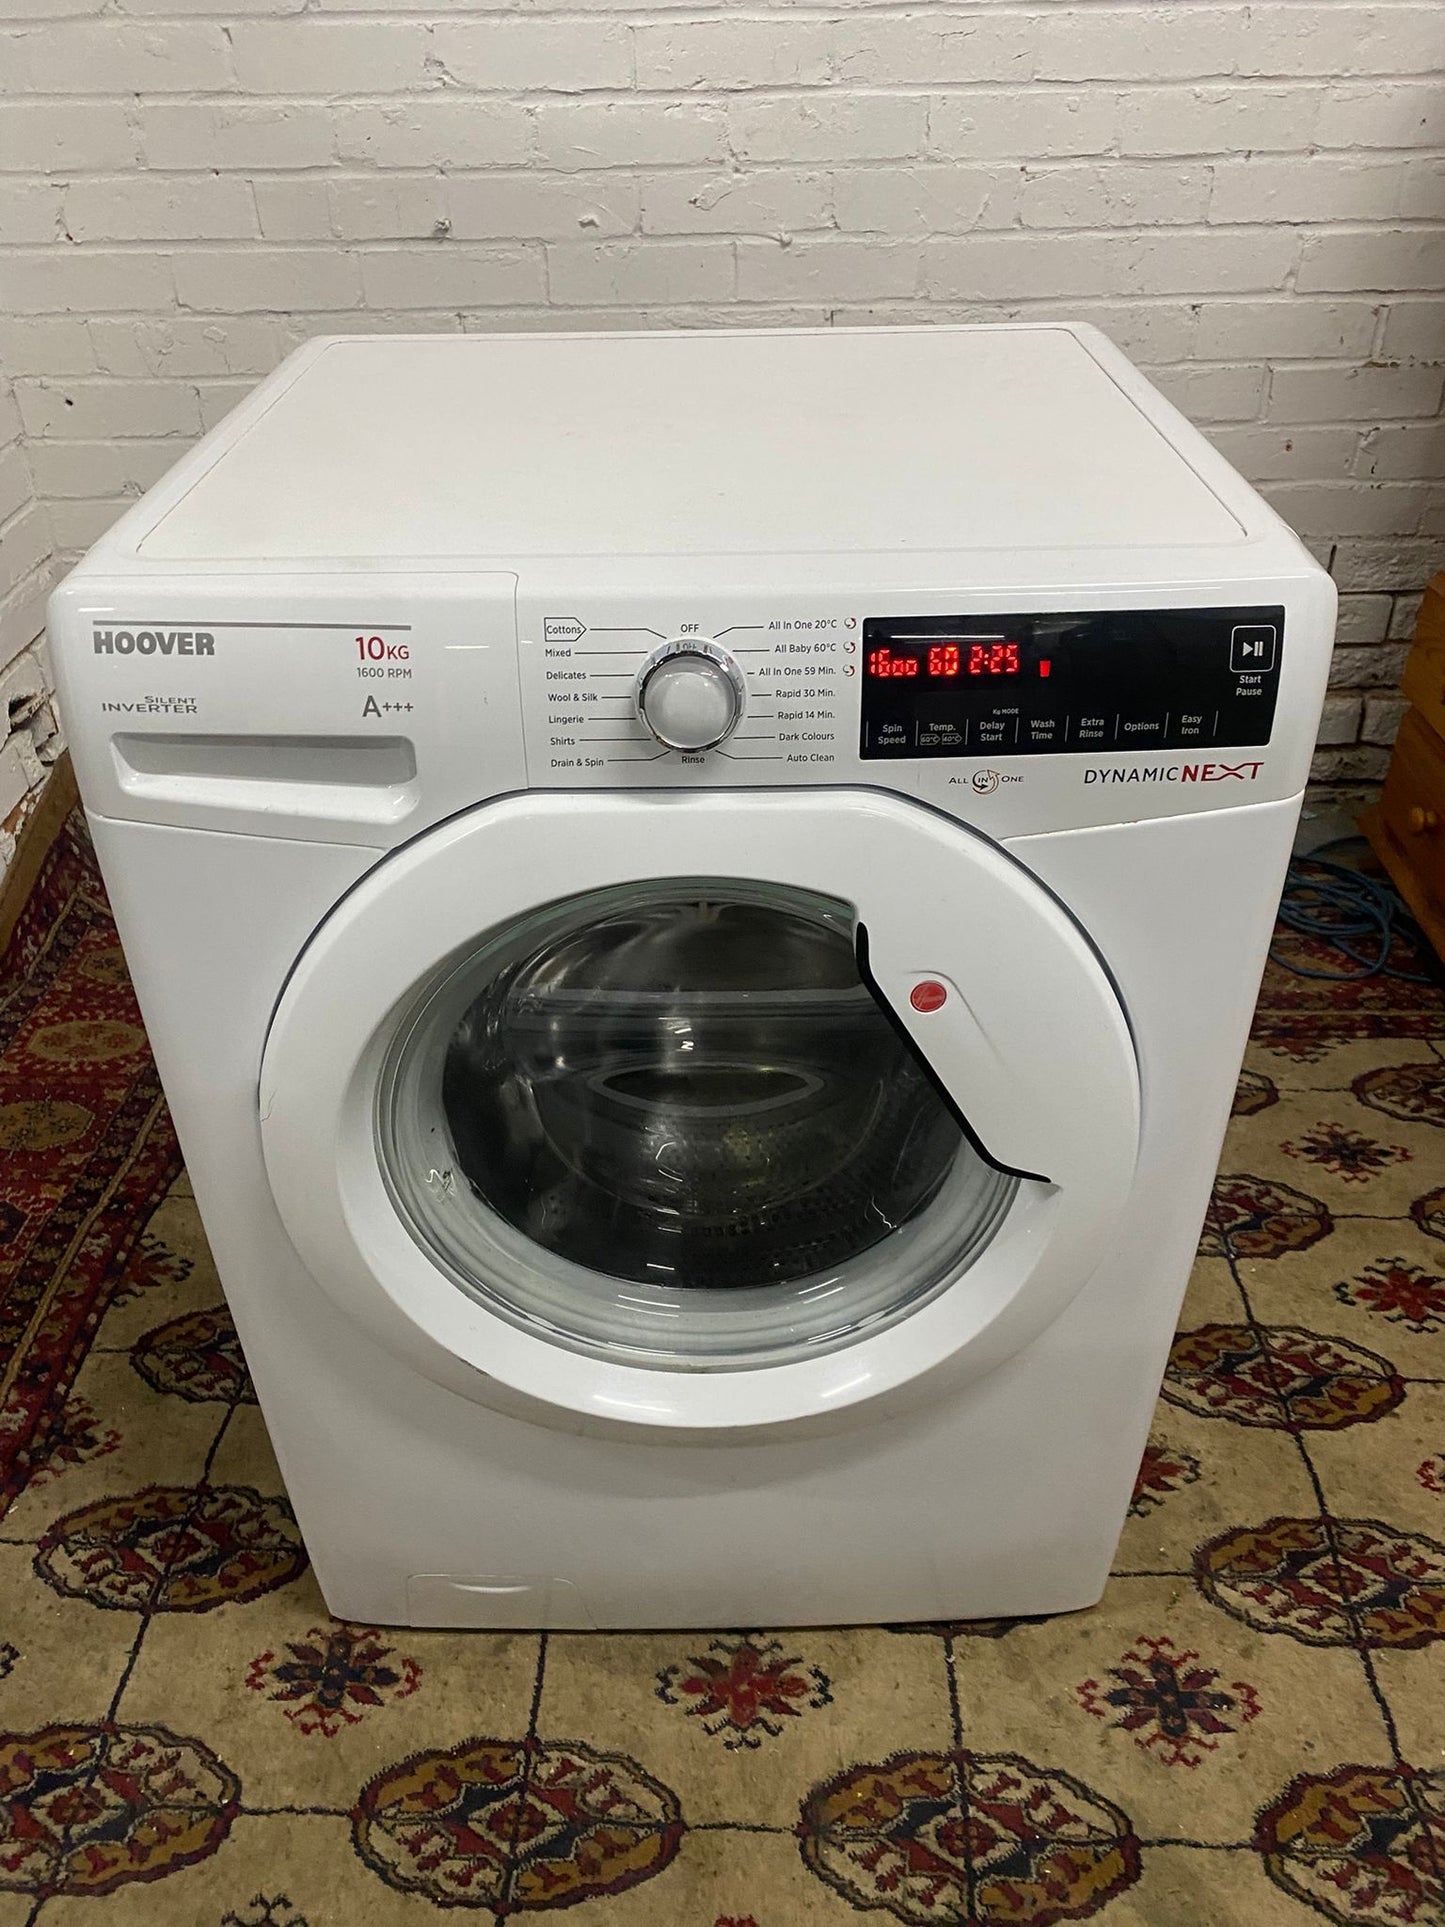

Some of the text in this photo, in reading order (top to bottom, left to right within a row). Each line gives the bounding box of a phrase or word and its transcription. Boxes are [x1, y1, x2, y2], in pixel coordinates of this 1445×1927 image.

[680, 624, 699, 633] OFF
[768, 619, 837, 630] All In One 20°C
[546, 625, 582, 635] Cottons
[93, 631, 216, 656] HOOVER
[774, 643, 836, 654] All Baby 60°C
[545, 649, 571, 657] Mixed
[929, 646, 959, 676] 60
[969, 644, 1019, 674] 2:25
[356, 667, 412, 679] 1600 RPM
[546, 671, 587, 680] Delicates
[759, 666, 836, 676] All In One 59 Min.
[1239, 675, 1262, 684] Start
[775, 689, 836, 699] Rapid 30 Min.
[1235, 687, 1263, 696] Pause
[144, 695, 197, 704] SILENT
[548, 693, 571, 702] Wool
[582, 693, 598, 702] Silk
[101, 702, 197, 714] INVERTER
[362, 695, 414, 718] A+++
[1002, 707, 1019, 715] MODE
[548, 715, 584, 725] Lingerie
[777, 710, 835, 720] Rapid 14 Min.
[1181, 714, 1202, 725] Easy
[979, 721, 1005, 732] Delay
[1030, 720, 1055, 729] Wash
[1080, 717, 1105, 727] Extra
[1124, 721, 1160, 732] Options
[882, 723, 903, 734] Spin
[929, 723, 956, 733] Temp.
[1181, 726, 1199, 735] Iron
[779, 731, 835, 741] Dark Colours
[980, 732, 1003, 741] Start
[1031, 731, 1053, 740] Time
[1079, 729, 1104, 738] Rinse
[550, 737, 576, 746] Shirts
[878, 735, 906, 745] Speed
[681, 756, 705, 764] Rinse
[787, 753, 835, 762] Auto Clean
[551, 758, 604, 768] Drain & Spin
[948, 775, 1025, 785] ALL IN ONE
